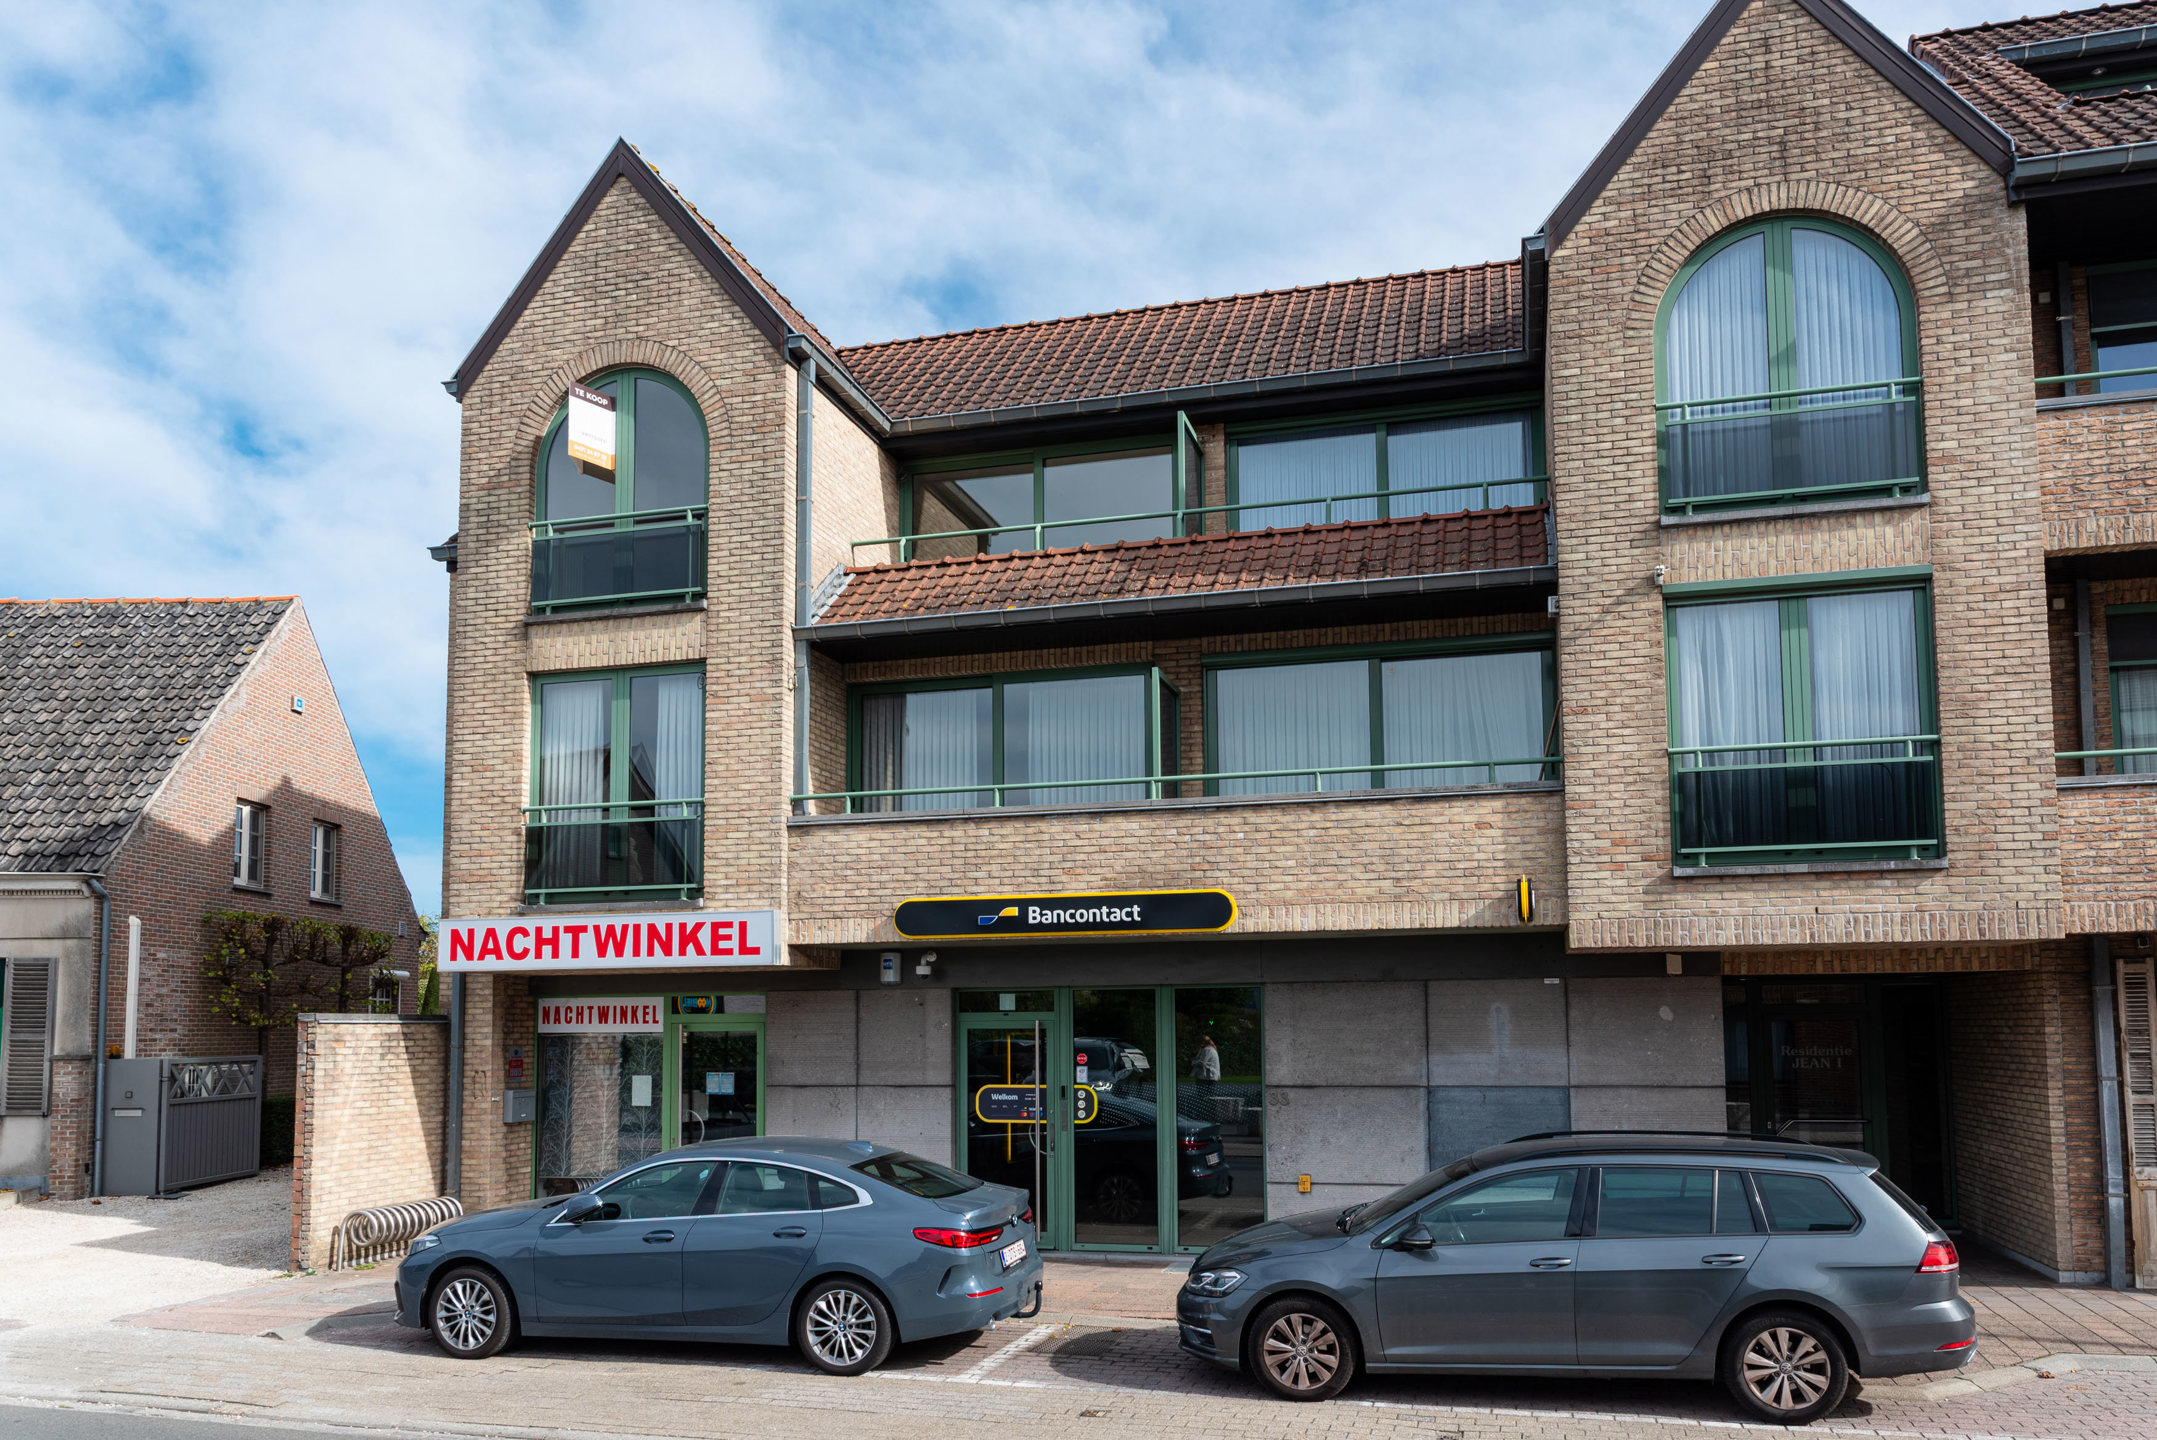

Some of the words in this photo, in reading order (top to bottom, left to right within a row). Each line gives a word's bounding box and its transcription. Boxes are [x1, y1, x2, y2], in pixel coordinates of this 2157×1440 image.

[574, 387, 585, 397] TE
[586, 391, 608, 406] KOOP
[1028, 904, 1141, 925] Bancontact
[449, 920, 761, 962] NACHTWINKEL
[542, 1004, 660, 1025] NACHTWINKEL
[1781, 1045, 1853, 1056] Residentie
[1791, 1057, 1831, 1069] JEAN
[991, 1093, 1019, 1101] Welkom
[1268, 1090, 1290, 1106] 33
